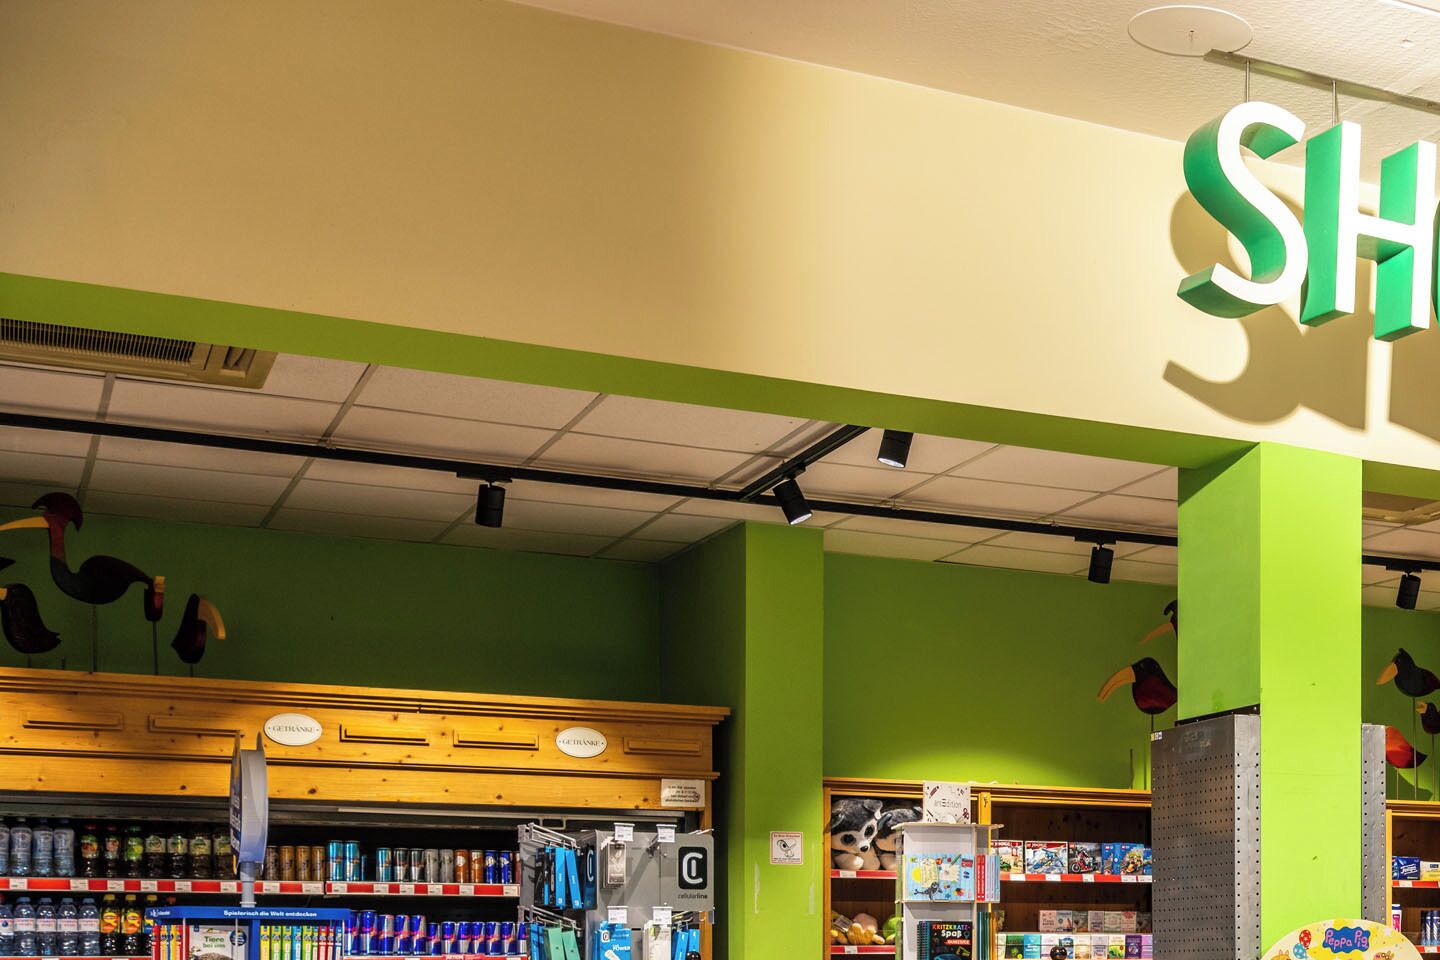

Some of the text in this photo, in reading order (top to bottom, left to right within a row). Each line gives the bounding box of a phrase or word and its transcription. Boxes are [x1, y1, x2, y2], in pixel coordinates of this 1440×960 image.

[931, 923, 971, 932] KRITZKRATZ-
[941, 929, 963, 938] Spaß
[204, 935, 225, 944] Tiere
[1325, 929, 1369, 948] Peppa Pig
